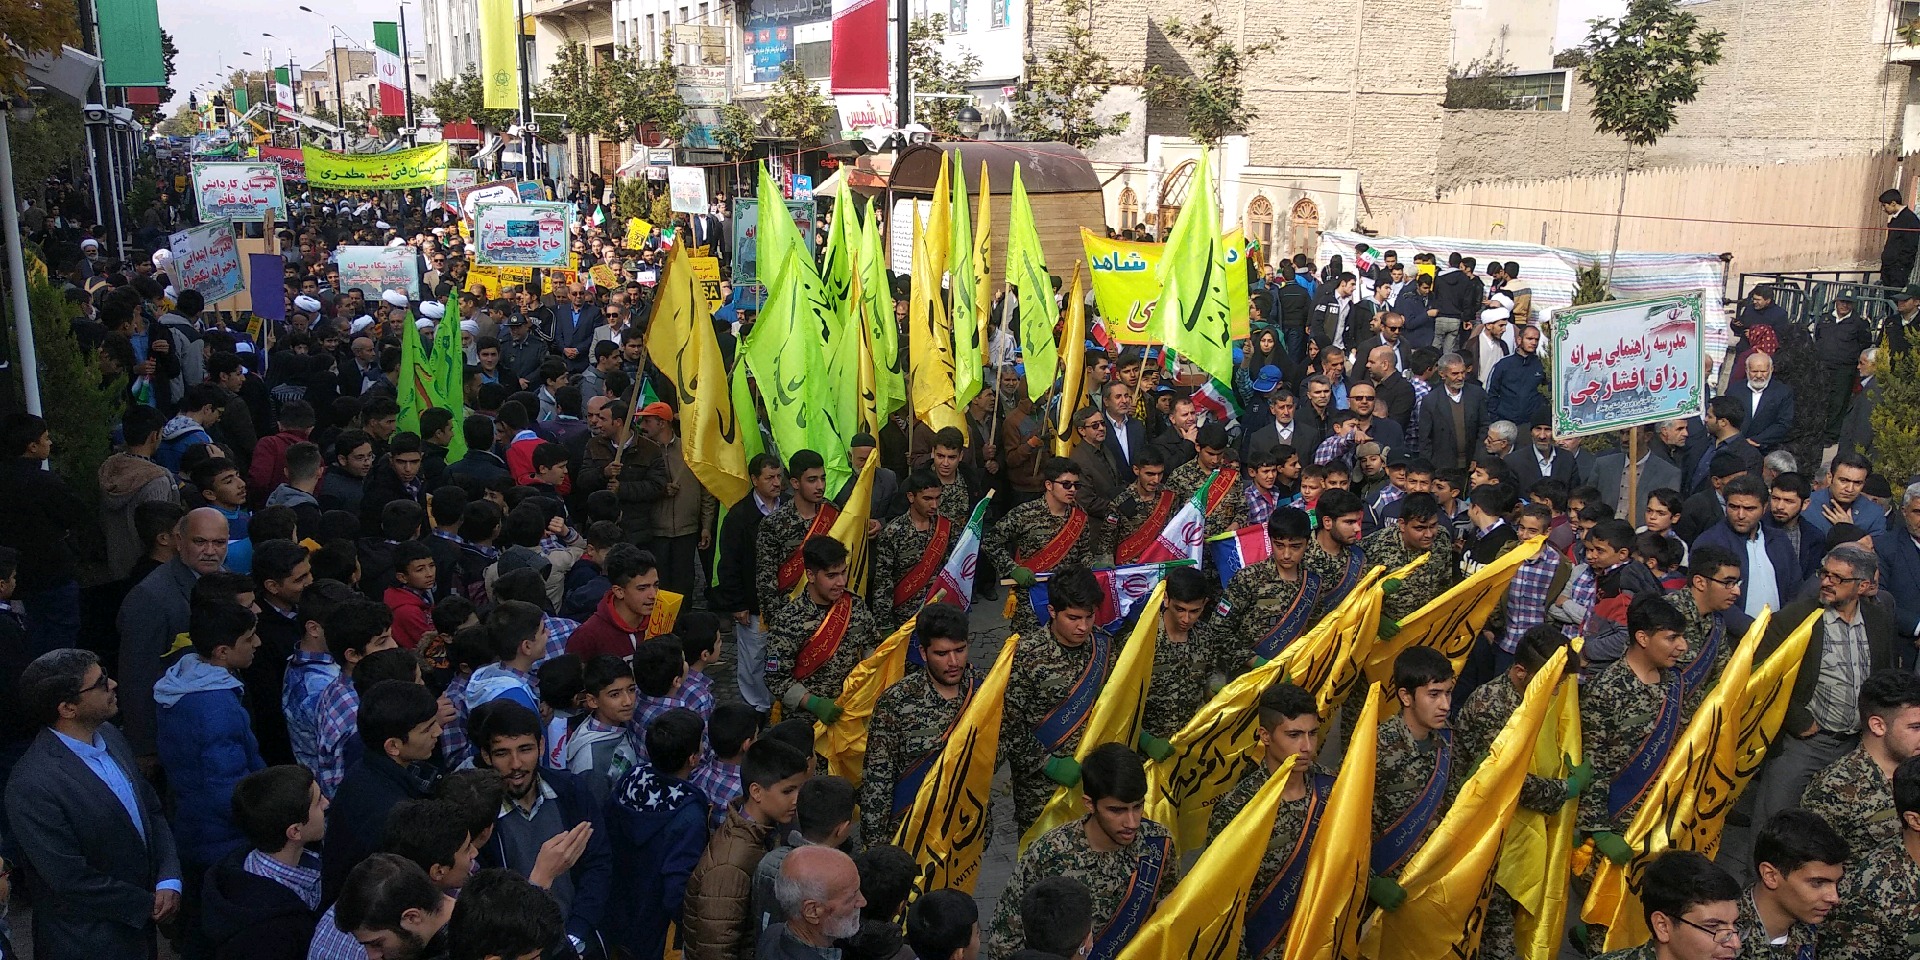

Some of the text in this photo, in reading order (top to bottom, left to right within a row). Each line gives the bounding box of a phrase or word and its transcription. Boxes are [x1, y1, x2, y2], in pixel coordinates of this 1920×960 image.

[320, 159, 447, 182] هنرستان فنی شهید مطهری
[202, 179, 278, 192] هنرستان کاردانش
[217, 193, 237, 207] قائم
[474, 189, 504, 202] دبیرستان
[484, 220, 506, 233] پسرانه
[540, 222, 564, 235] مدرسه
[209, 242, 233, 258] مدرسه
[486, 237, 561, 251] حاج احمد خمینی
[346, 261, 404, 272] آموزشگاه پسرانه
[1092, 251, 1147, 272] شاهد
[702, 286, 719, 299] SA
[1570, 333, 1686, 371] مدرسه راهنمایی پسرانه
[1570, 363, 1688, 405] رزاق افشارچی
[953, 860, 979, 887] WITH
